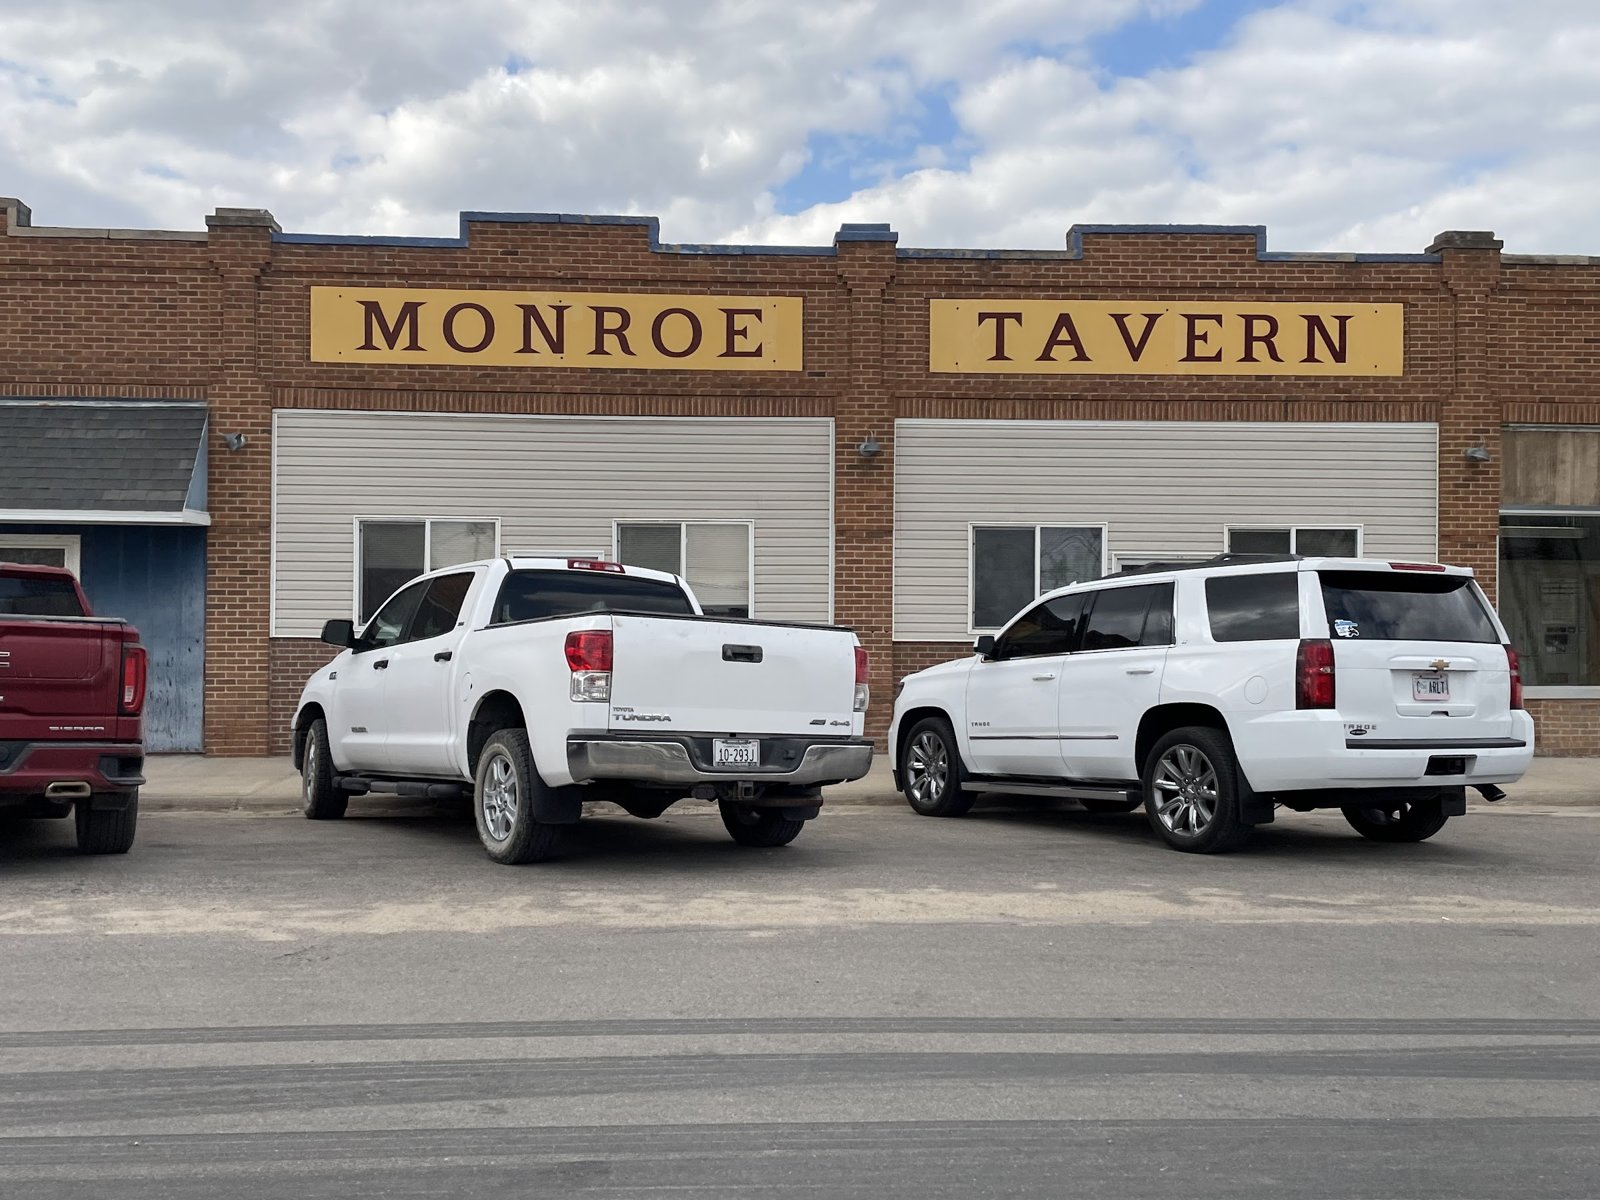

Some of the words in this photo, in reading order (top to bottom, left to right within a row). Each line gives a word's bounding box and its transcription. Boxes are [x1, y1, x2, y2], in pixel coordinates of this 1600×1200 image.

[355, 300, 763, 358] MONROE
[978, 312, 1354, 364] TAVERN
[612, 713, 672, 722] TUNDRA
